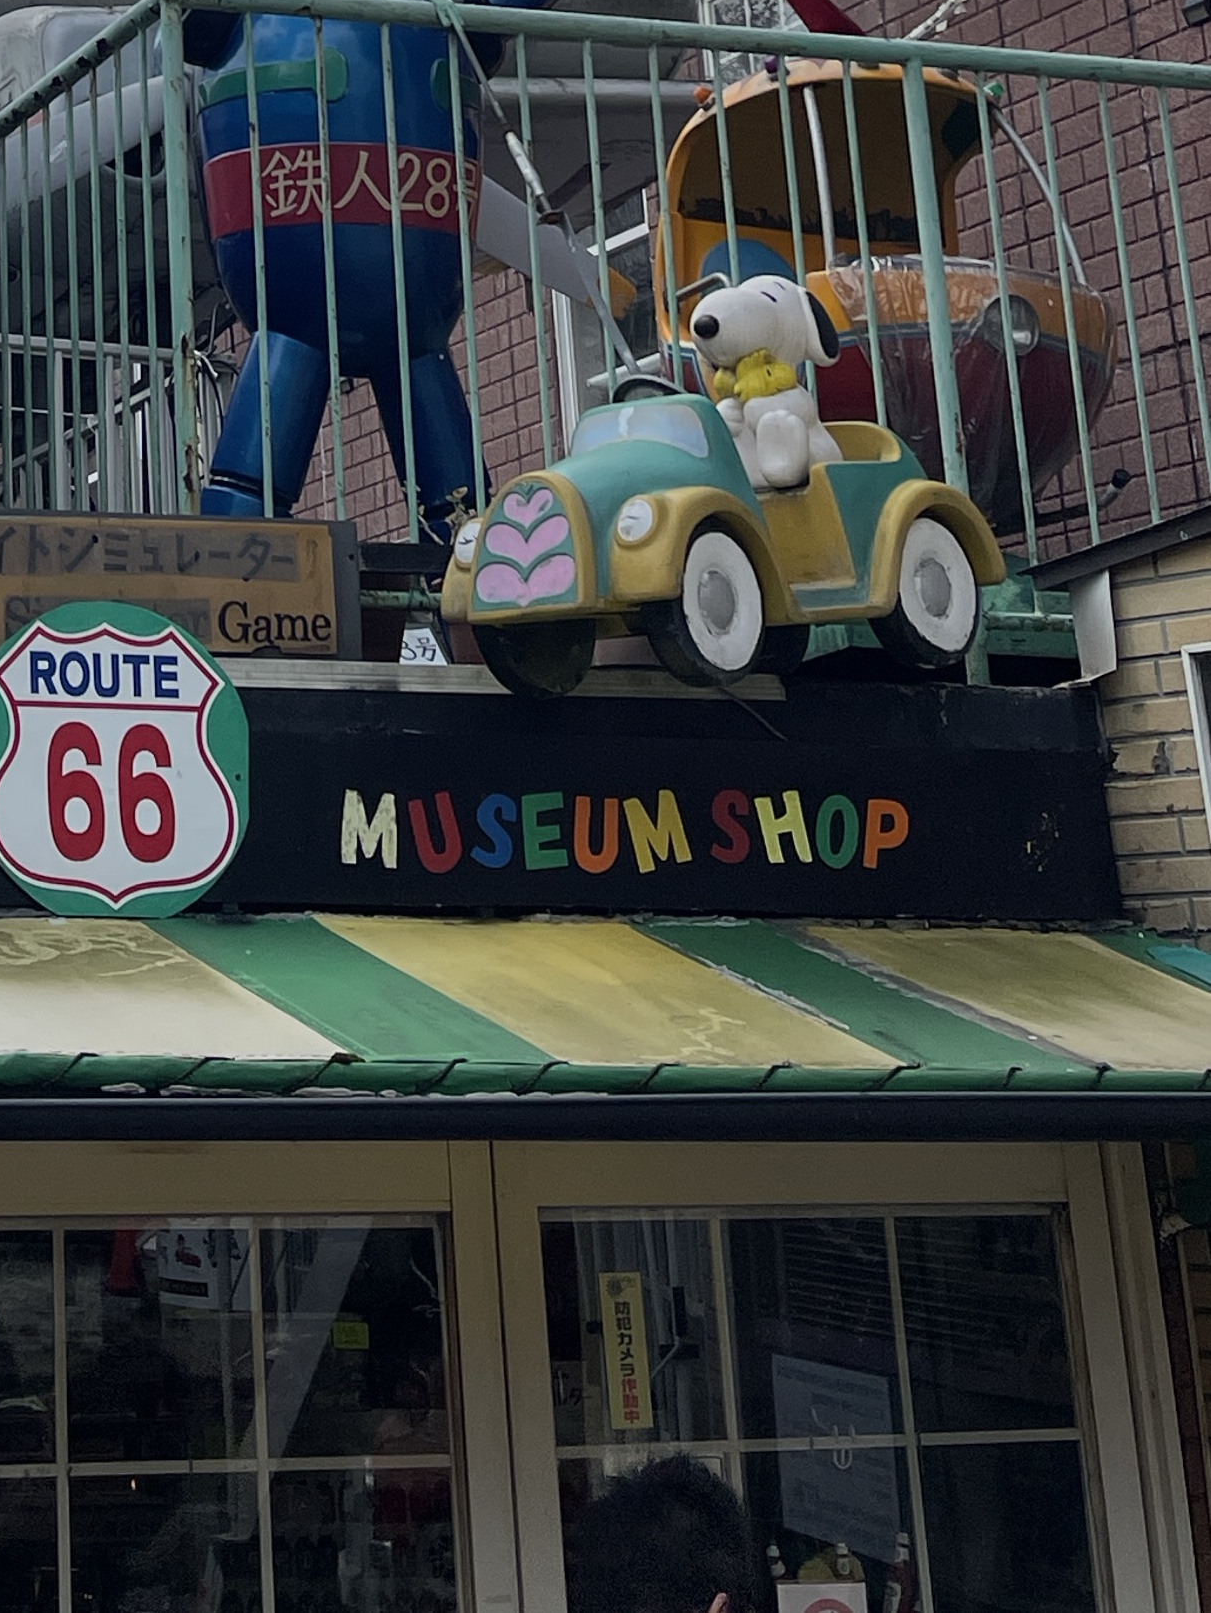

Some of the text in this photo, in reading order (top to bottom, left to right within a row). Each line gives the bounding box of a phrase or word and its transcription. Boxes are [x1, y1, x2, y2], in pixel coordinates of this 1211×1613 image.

[262, 149, 477, 222] 鉄人28号
[218, 601, 332, 646] Game
[29, 650, 180, 699] ROUTE
[47, 721, 176, 863] 66
[341, 789, 909, 874] MUSEUM SHOP
[614, 1300, 640, 1424] 防犯カメラ作動中
